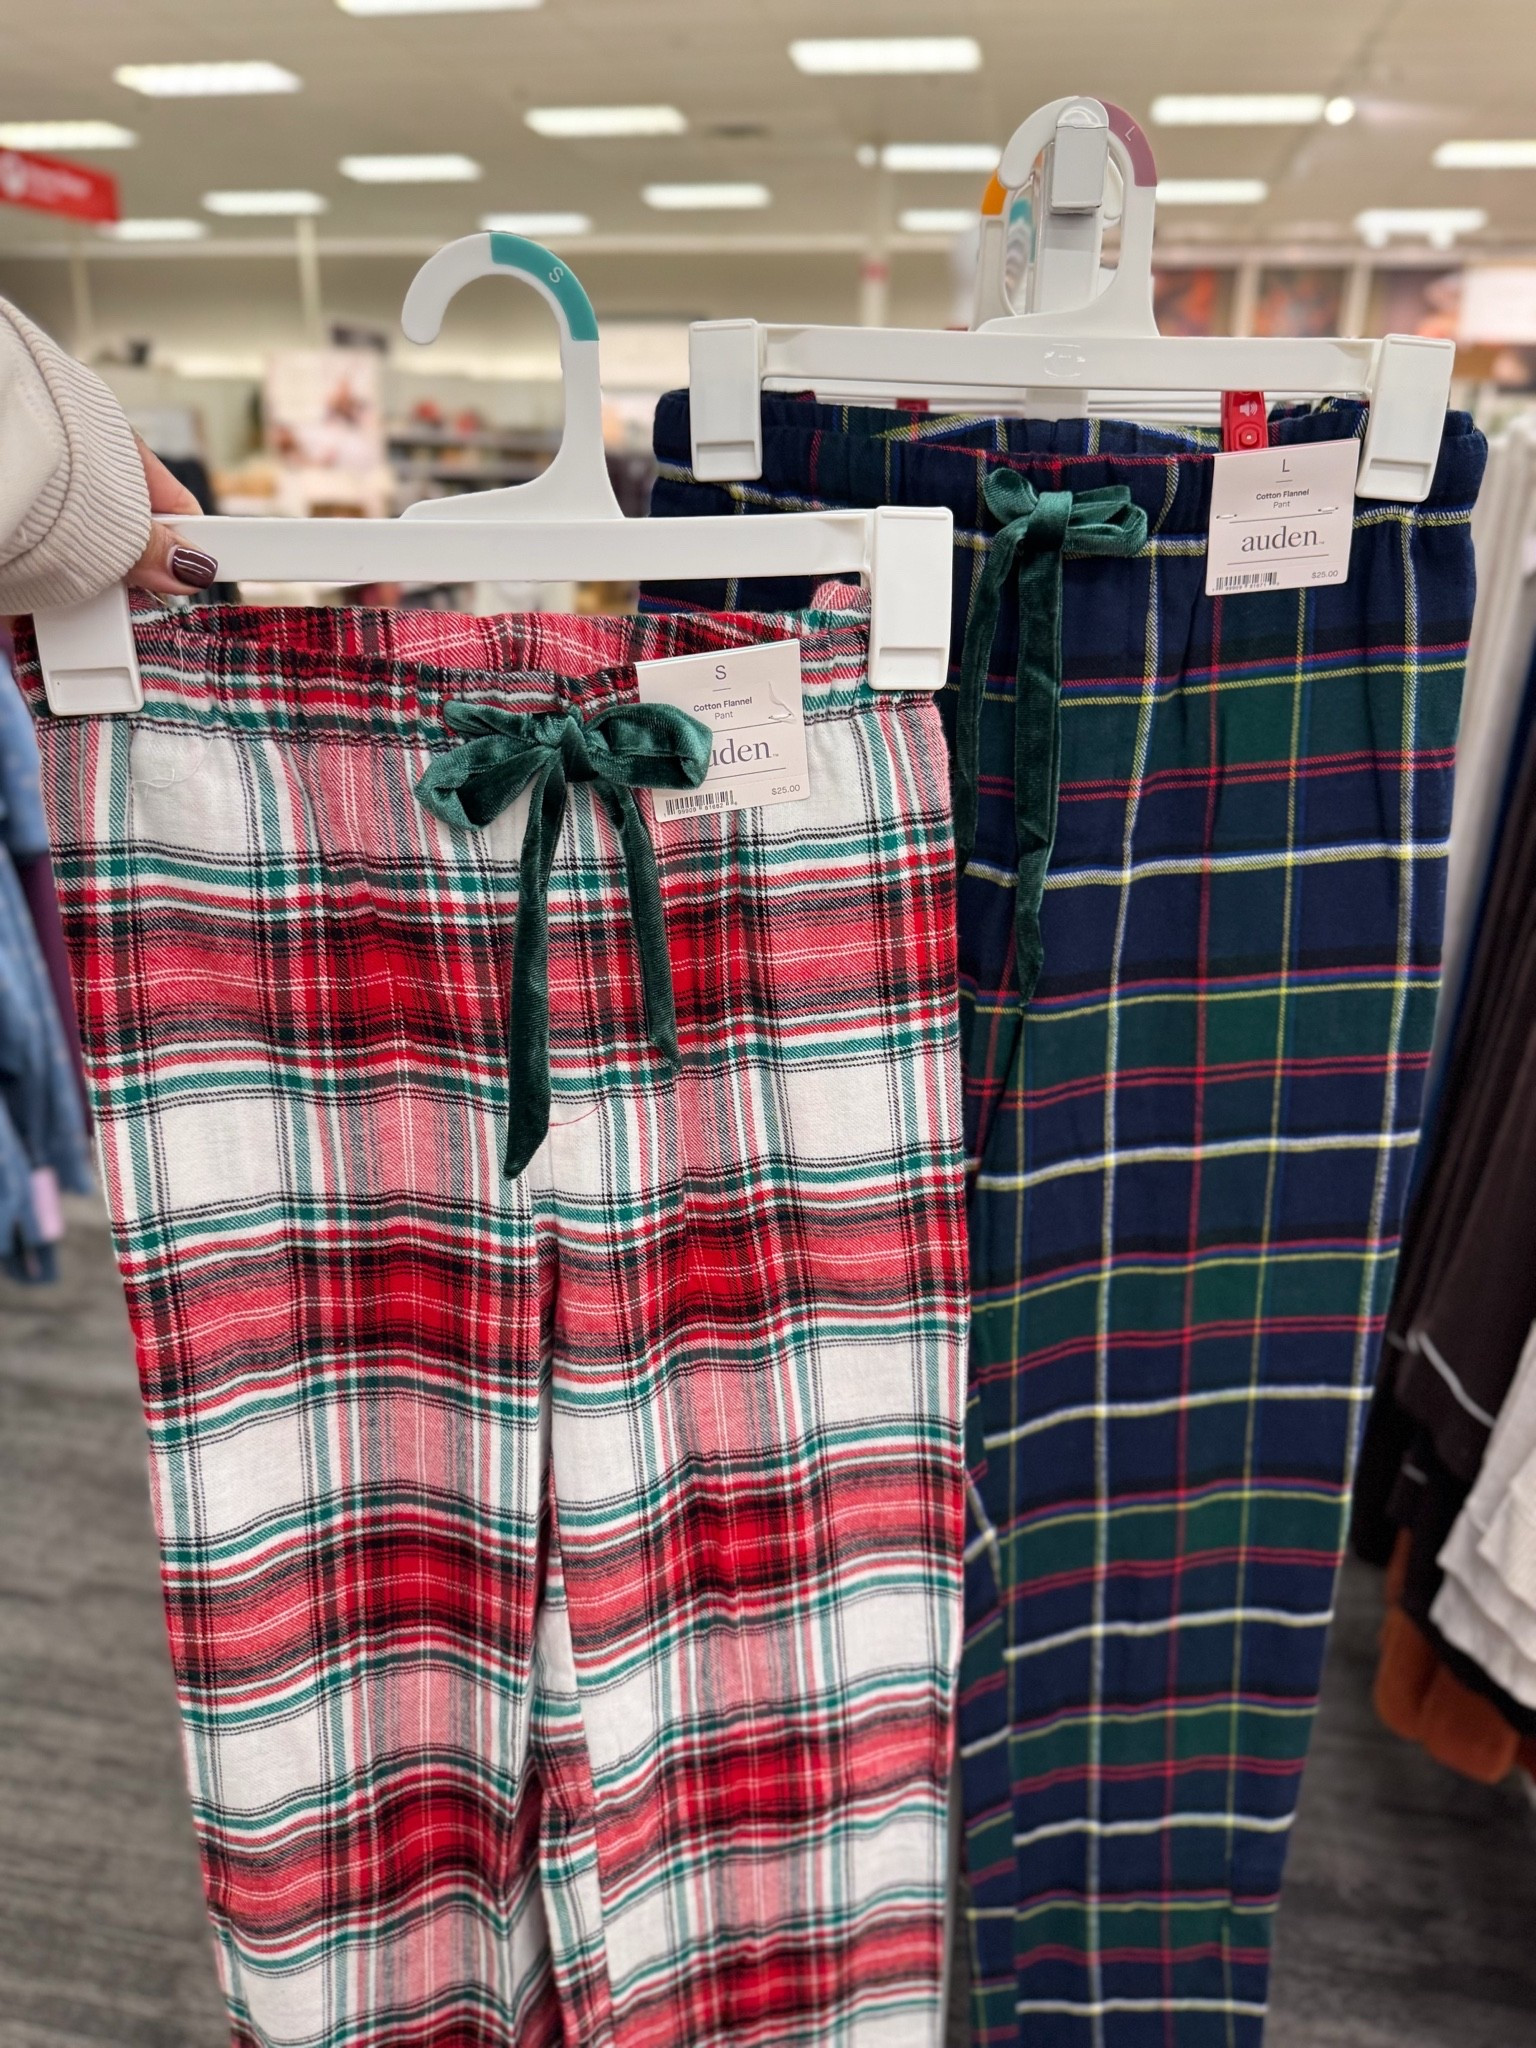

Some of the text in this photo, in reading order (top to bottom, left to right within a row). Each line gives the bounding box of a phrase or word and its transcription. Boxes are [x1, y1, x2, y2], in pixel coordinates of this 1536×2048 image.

[1124, 125, 1136, 142] L
[548, 266, 564, 284] S
[1281, 458, 1291, 473] L
[1255, 488, 1310, 501] Cotton Flannel
[1273, 501, 1291, 509] Pant
[1311, 570, 1339, 580] $25.00
[715, 665, 727, 680] S
[693, 697, 753, 713] Cotton Flannel
[714, 711, 734, 720] Pant
[709, 738, 772, 767] uden
[771, 784, 801, 796] $25.00
